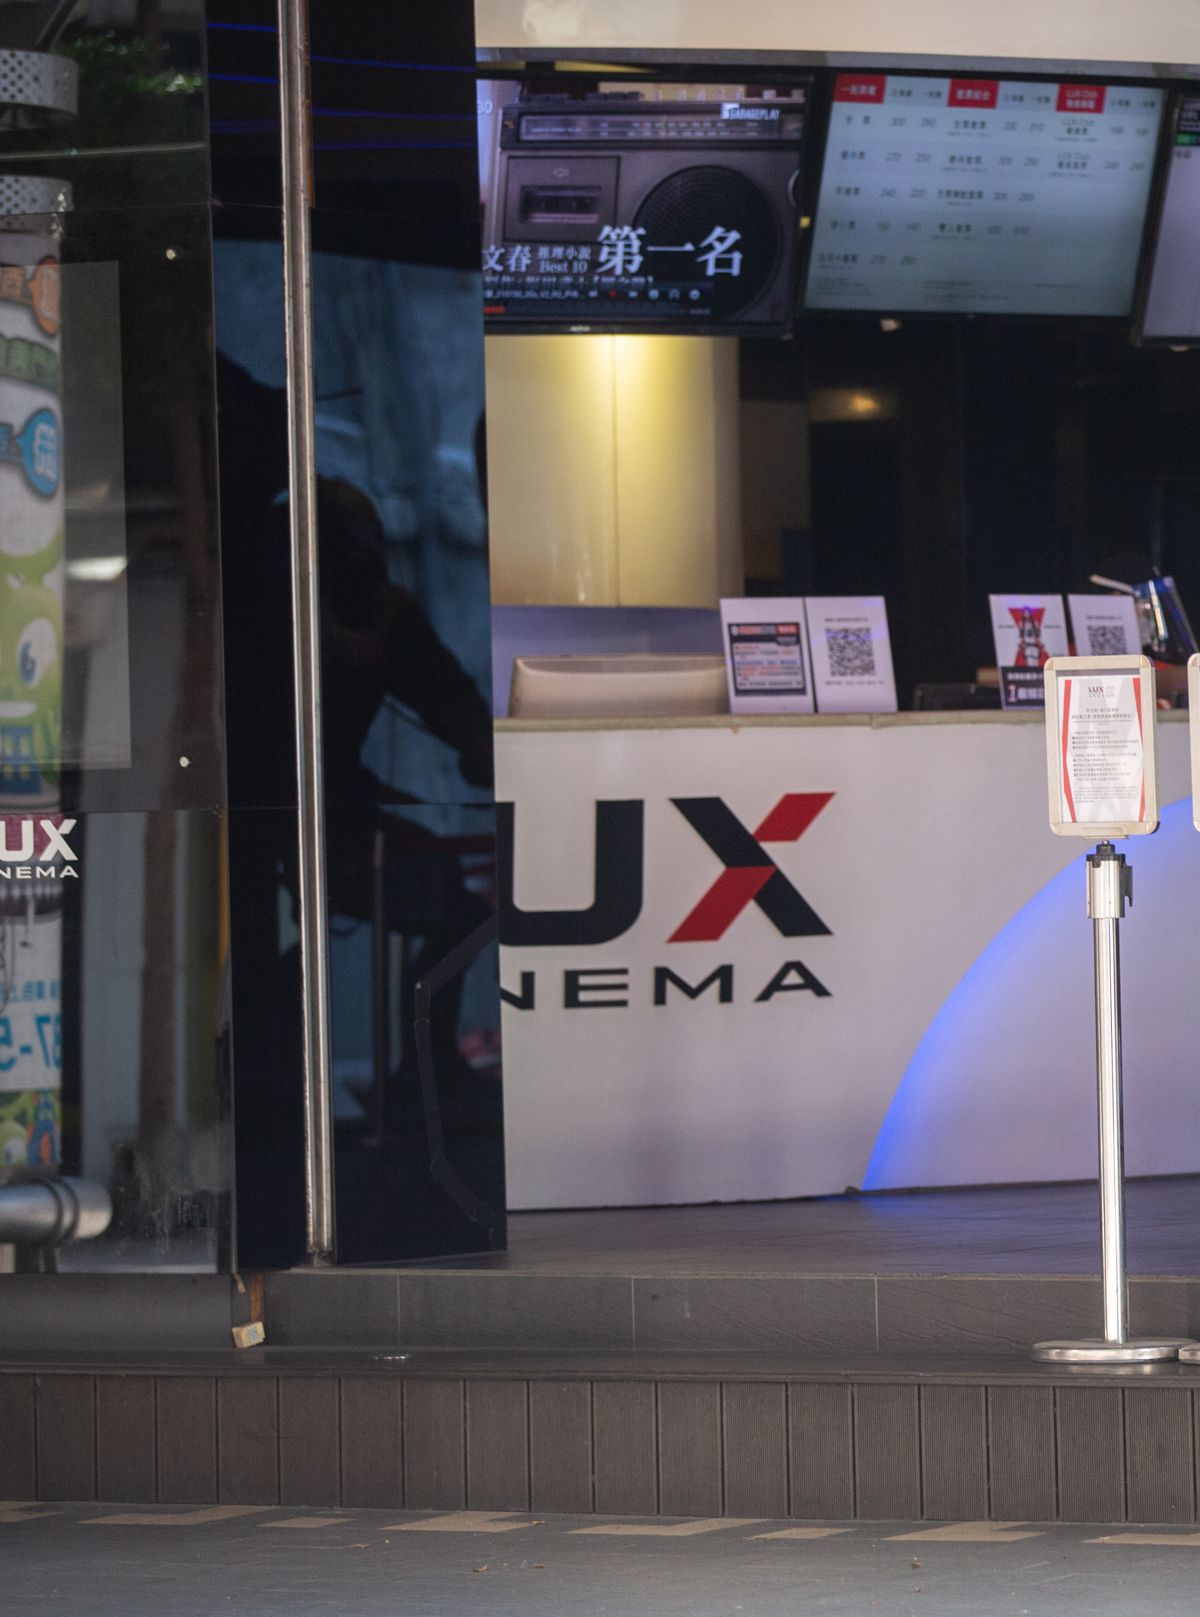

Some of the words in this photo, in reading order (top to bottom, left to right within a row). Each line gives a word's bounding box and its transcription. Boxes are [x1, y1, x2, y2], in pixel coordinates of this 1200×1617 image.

[483, 244, 532, 272] 文春
[597, 225, 743, 277] 第一名
